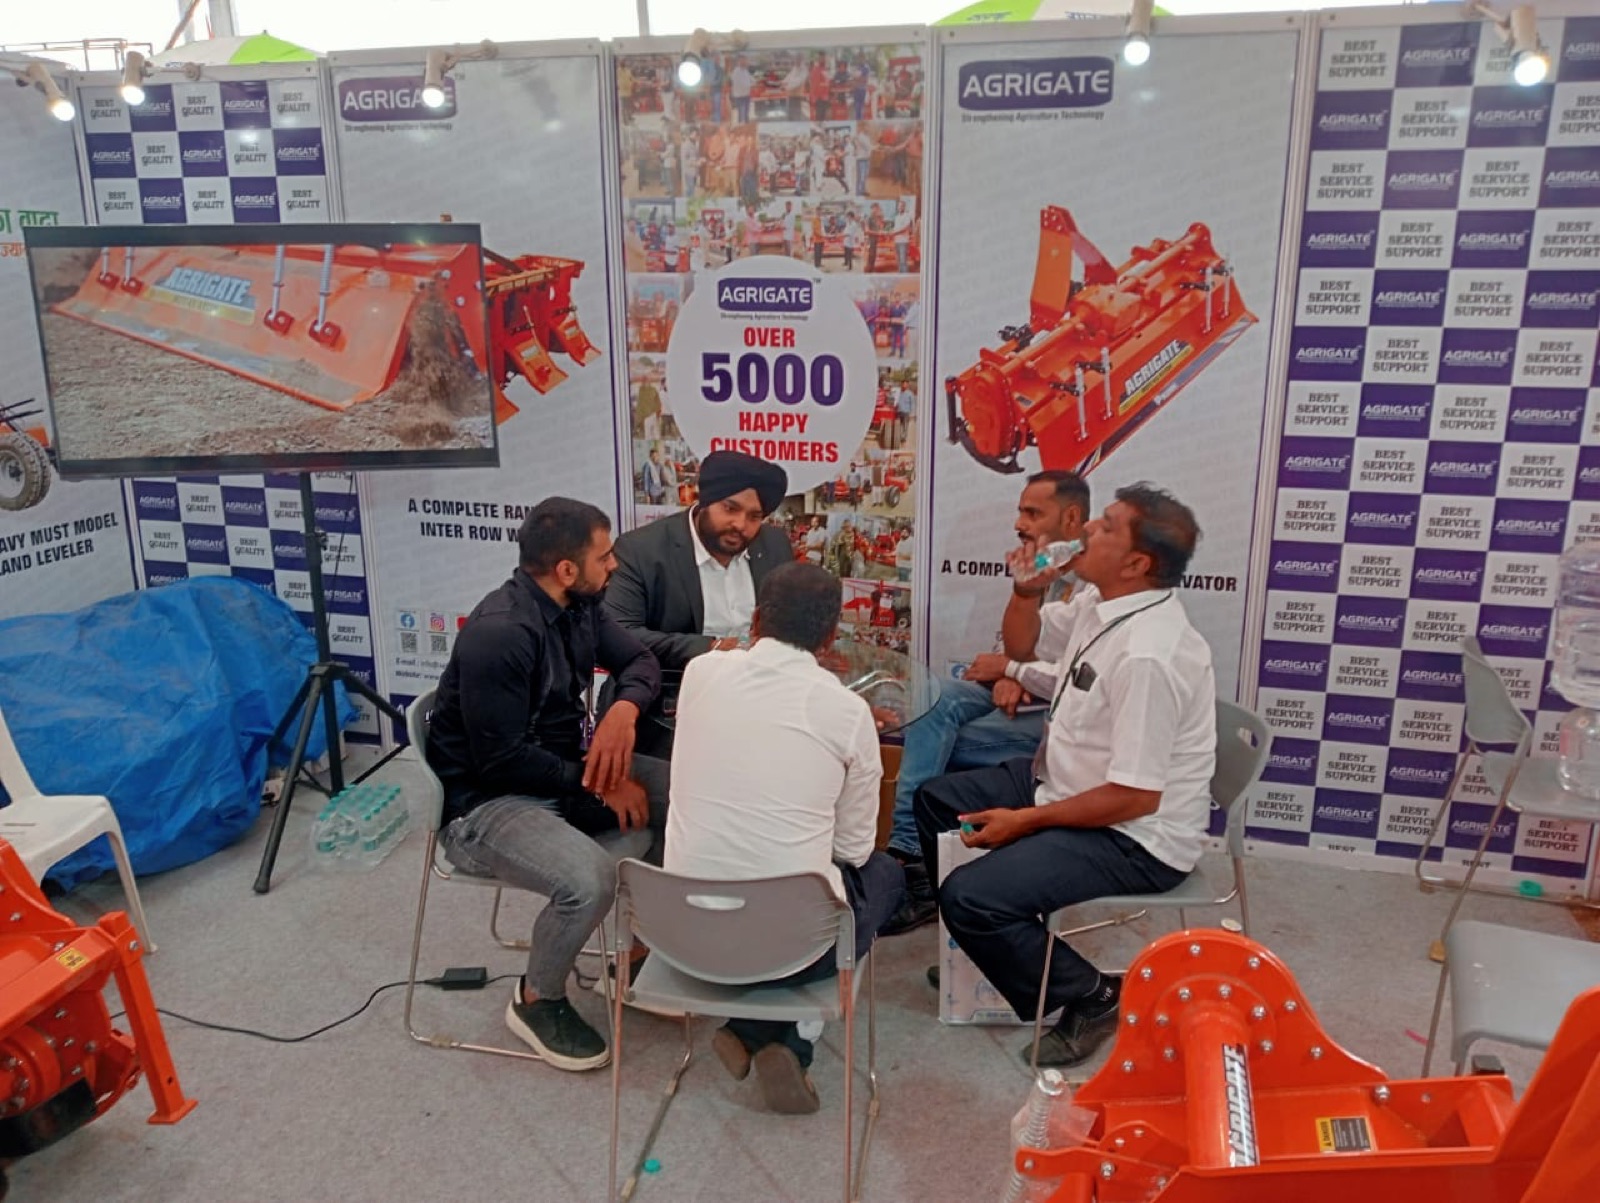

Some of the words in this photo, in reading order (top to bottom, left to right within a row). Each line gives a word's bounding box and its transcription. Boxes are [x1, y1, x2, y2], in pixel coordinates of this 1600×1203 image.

[1344, 40, 1376, 50] BEST
[1331, 53, 1386, 64] SERVICE
[1402, 48, 1471, 62] AGRIGATE
[1328, 66, 1386, 78] SUPPORT
[963, 70, 1110, 98] AGRIGATE
[343, 87, 453, 111] AGRIGAE
[1414, 101, 1448, 112] BEST
[1319, 114, 1383, 126] AGRIGATE
[1474, 109, 1544, 123] AGRIGATE
[1399, 126, 1458, 138] SUPPORT
[1332, 163, 1364, 174] BEST
[1485, 162, 1519, 172] BEST
[1320, 176, 1373, 187] SERVICE
[1389, 173, 1455, 186] AGRIGATE
[1472, 174, 1529, 185] SERVICE
[1317, 188, 1373, 199] SUPPORT
[1469, 186, 1529, 198] SUPPORT
[1401, 223, 1433, 233] BEST
[1308, 233, 1371, 245] AGRIGATE
[1388, 235, 1443, 246] SERVICE
[1459, 233, 1525, 245] AGRIGATE
[1385, 247, 1443, 258] SUPPORT
[163, 267, 251, 304] AGRIGATE
[1320, 281, 1351, 291] BEST
[1470, 281, 1501, 292] BEST
[720, 286, 811, 304] AGRIGATE
[1308, 292, 1360, 303] SERVICE
[1376, 291, 1440, 304] AGRIGATE
[1457, 294, 1513, 304] SERVICE
[1529, 292, 1596, 306] AGRIGATE
[1306, 304, 1360, 315] SUPPORT
[1454, 306, 1512, 317] SUPPORT
[744, 327, 795, 348] OVER
[1387, 339, 1419, 349] BEST
[1539, 341, 1573, 352] BEST
[1296, 348, 1359, 360] AGRIGATE
[1375, 350, 1429, 361] SERVICE
[1443, 349, 1509, 363] AGRIGATE
[1526, 353, 1583, 364] SERVICE
[1125, 340, 1180, 396] AGRIGATE
[1373, 361, 1429, 373] SUPPORT
[1523, 364, 1583, 376] SUPPORT
[701, 352, 844, 406] 5000
[1308, 393, 1339, 403] BEST
[1455, 397, 1487, 408] BEST
[1296, 404, 1349, 415] SERVICE
[1363, 404, 1426, 417] AGRIGATE
[1442, 408, 1496, 420] SERVICE
[1511, 408, 1578, 421] AGRIGATE
[739, 412, 808, 433] HAPPY
[1294, 415, 1348, 426] SUPPORT
[1440, 420, 1496, 431] SUPPORT
[710, 437, 839, 462] CUSTOMERS
[1375, 450, 1405, 460] BEST
[1285, 456, 1346, 468] AGRIGATE
[1522, 455, 1555, 466] BEST
[1363, 461, 1415, 472] SERVICE
[1430, 462, 1493, 474] AGRIGATE
[1360, 472, 1415, 483] SUPPORT
[1510, 467, 1565, 478] SERVICE
[1506, 478, 1564, 490] SUPPORT
[408, 498, 418, 512] A
[423, 499, 499, 518] COMPLETE
[1297, 500, 1326, 510] BEST
[1286, 510, 1336, 522] SERVICE
[1440, 507, 1471, 518] BEST
[1351, 512, 1412, 525] AGRIGATE
[1429, 518, 1481, 529] SERVICE
[420, 521, 463, 539] INTER
[469, 525, 502, 541] ROW
[1283, 522, 1336, 533] SUPPORT
[1496, 519, 1560, 532] AGRIGATE
[0, 532, 25, 553] AVY
[30, 522, 69, 546] MUST
[73, 512, 119, 536] MODEL
[1426, 529, 1481, 540] SUPPORT
[0, 554, 32, 576] AND
[36, 538, 94, 567] LEVELER
[1362, 556, 1392, 567] BEST
[941, 559, 952, 573] A
[958, 560, 1014, 577] COMPL
[1274, 561, 1335, 573] AGRIGATE
[1350, 567, 1401, 578] SERVICE
[1506, 563, 1539, 574] BEST
[1416, 568, 1477, 581] AGRIGATE
[1494, 574, 1547, 585] SERVICE
[1183, 575, 1237, 592] VATOR
[1348, 576, 1401, 588] SUPPORT
[1491, 585, 1547, 597] SUPPORT
[1286, 601, 1316, 612] BEST
[1275, 612, 1325, 623] SERVICE
[1339, 615, 1399, 628] AGRIGATE
[1426, 611, 1458, 621] BEST
[1273, 622, 1325, 633] SUPPORT
[1415, 621, 1466, 632] SERVICE
[1480, 625, 1544, 638] AGRIGATE
[1265, 659, 1323, 672] AGRIGATE
[1350, 656, 1379, 667] BEST
[1338, 666, 1389, 677] SERVICE
[1403, 670, 1463, 683] AGRIGATE
[1336, 676, 1389, 688] SUPPORT
[1276, 699, 1305, 709] BEST
[1265, 708, 1314, 720] SERVICE
[1328, 712, 1386, 726] AGRIGATE
[1414, 711, 1443, 721] BEST
[1402, 721, 1452, 732] SERVICE
[1400, 731, 1452, 742] SUPPORT
[1338, 752, 1367, 762] BEST
[1327, 762, 1376, 773] SERVICE
[1390, 766, 1449, 780] AGRIGATE
[1325, 772, 1376, 783] SUPPORT
[1267, 792, 1295, 802] BEST
[1256, 802, 1304, 812] SERVICE
[1317, 806, 1376, 819] AGRIGATE
[1254, 811, 1304, 822] SUPPORT
[1528, 829, 1579, 841] SERVICE
[1525, 838, 1579, 852] SUPPORT
